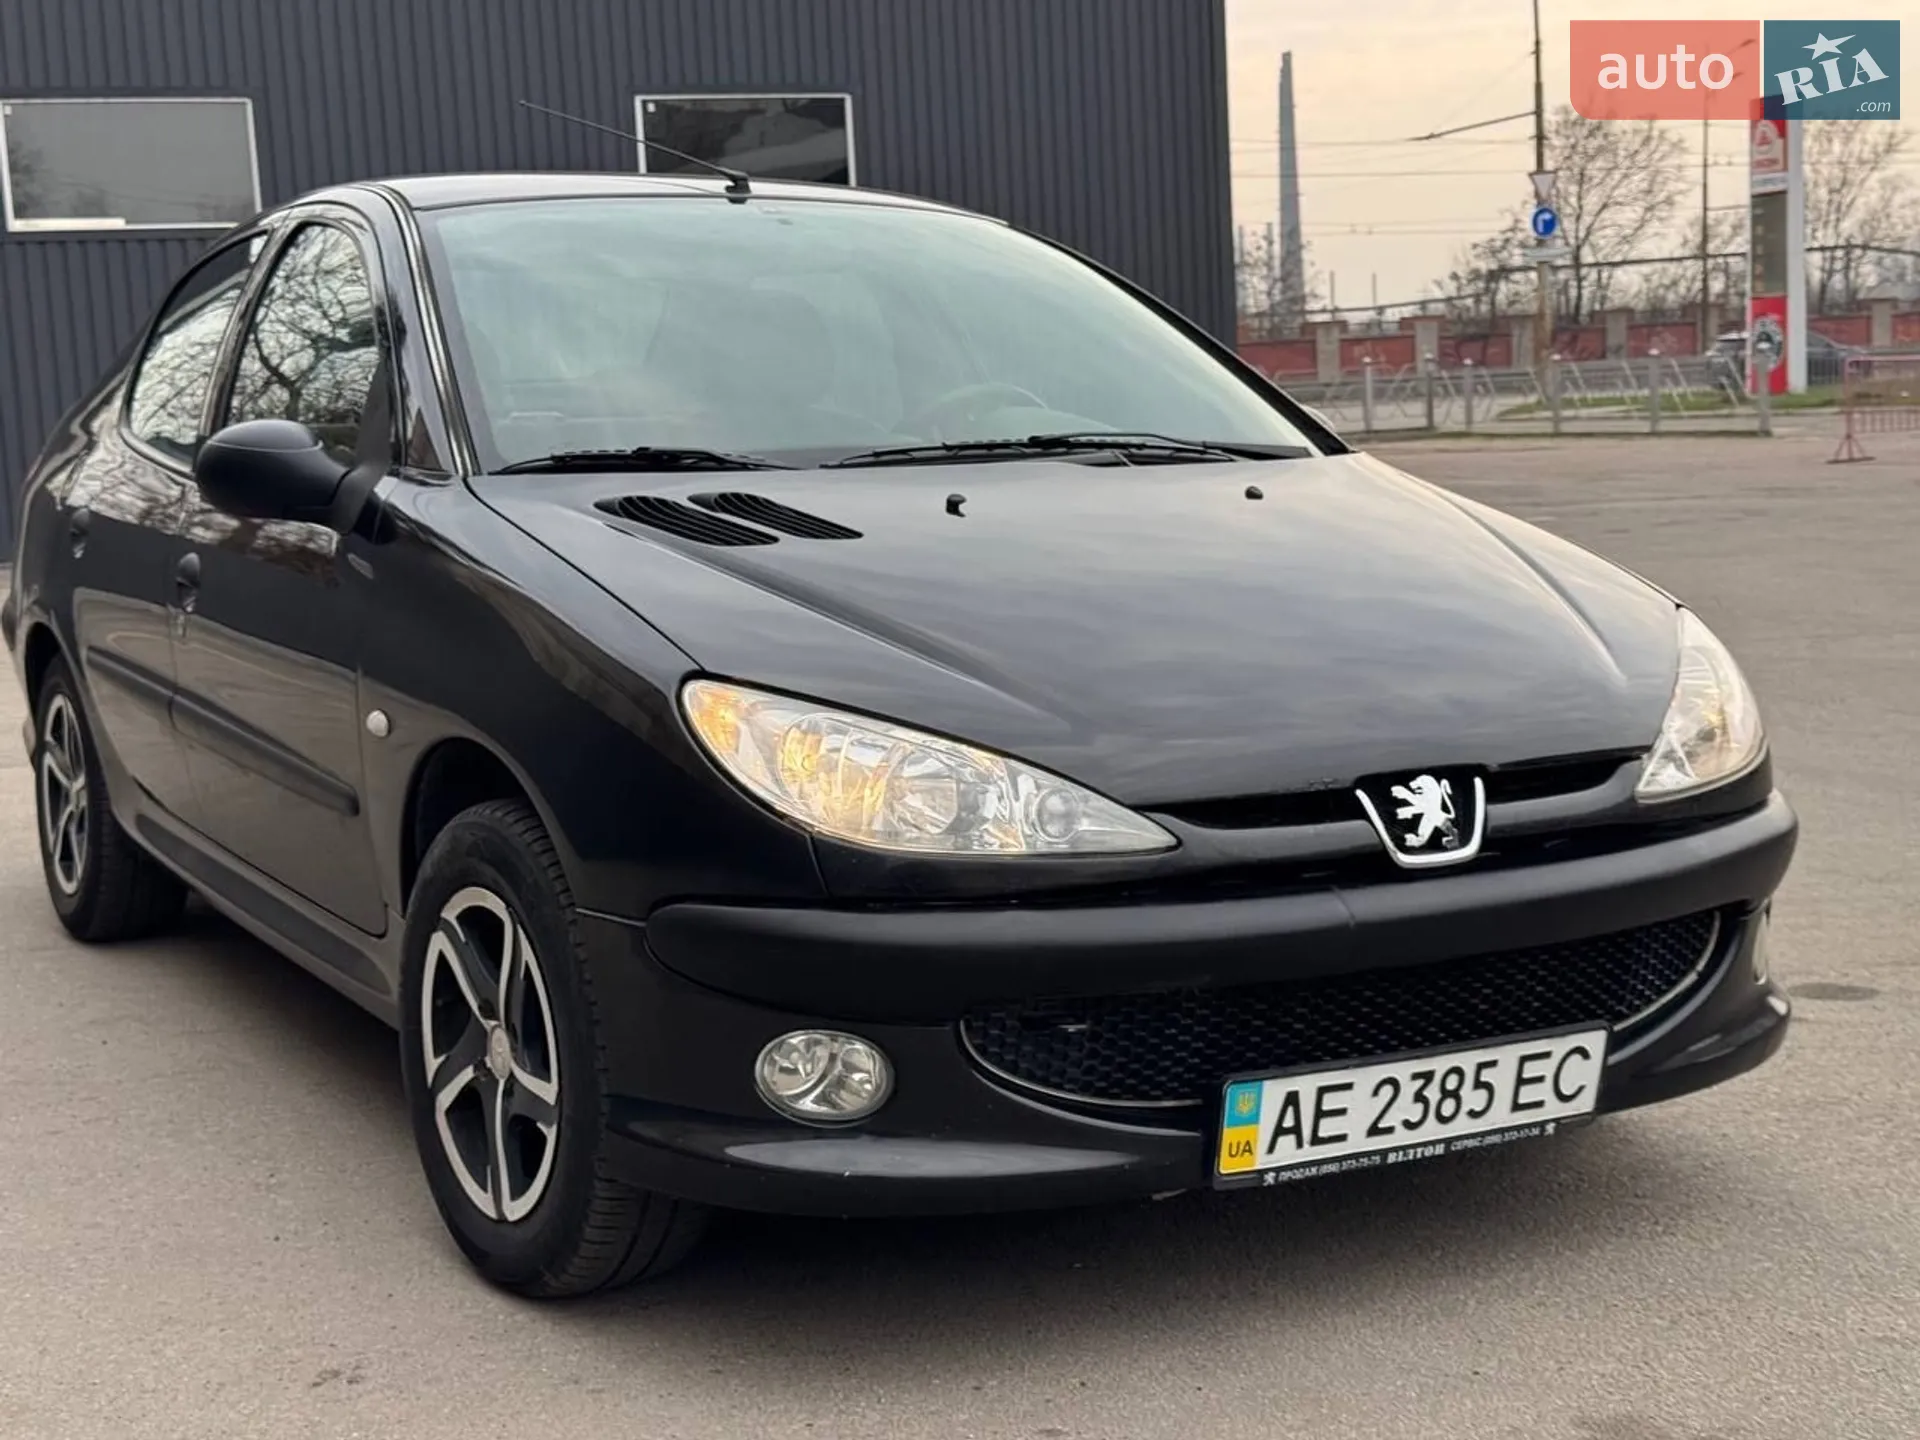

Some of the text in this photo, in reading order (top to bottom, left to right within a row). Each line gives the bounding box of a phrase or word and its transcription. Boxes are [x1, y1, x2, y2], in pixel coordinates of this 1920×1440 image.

[1265, 1045, 1591, 1155] AE 2385 EC
[1228, 1139, 1254, 1158] UA
